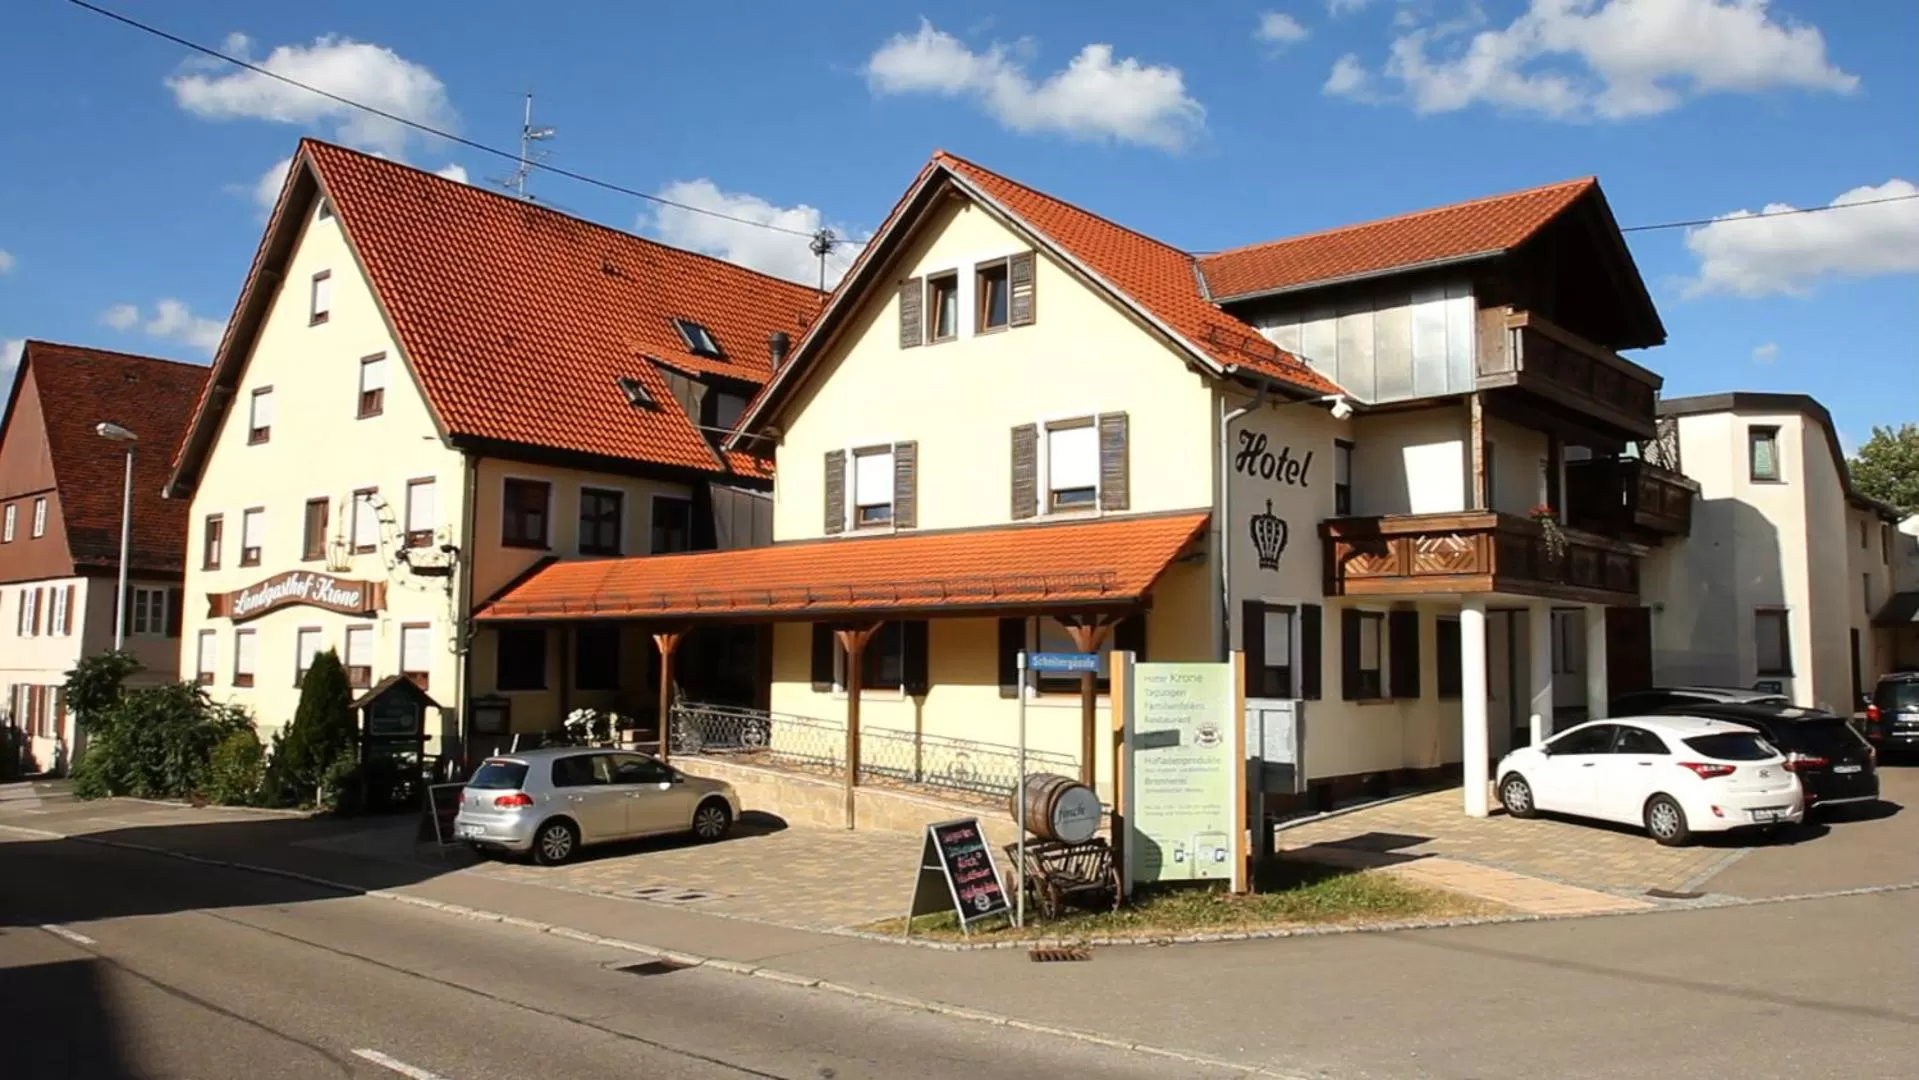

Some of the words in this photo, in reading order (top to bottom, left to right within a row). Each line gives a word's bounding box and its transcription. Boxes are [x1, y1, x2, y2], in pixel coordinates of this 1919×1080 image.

[1235, 429, 1314, 488] Hotel
[234, 573, 315, 614] Landgasthof
[312, 577, 359, 607] Krone
[1169, 672, 1204, 683] Krone
